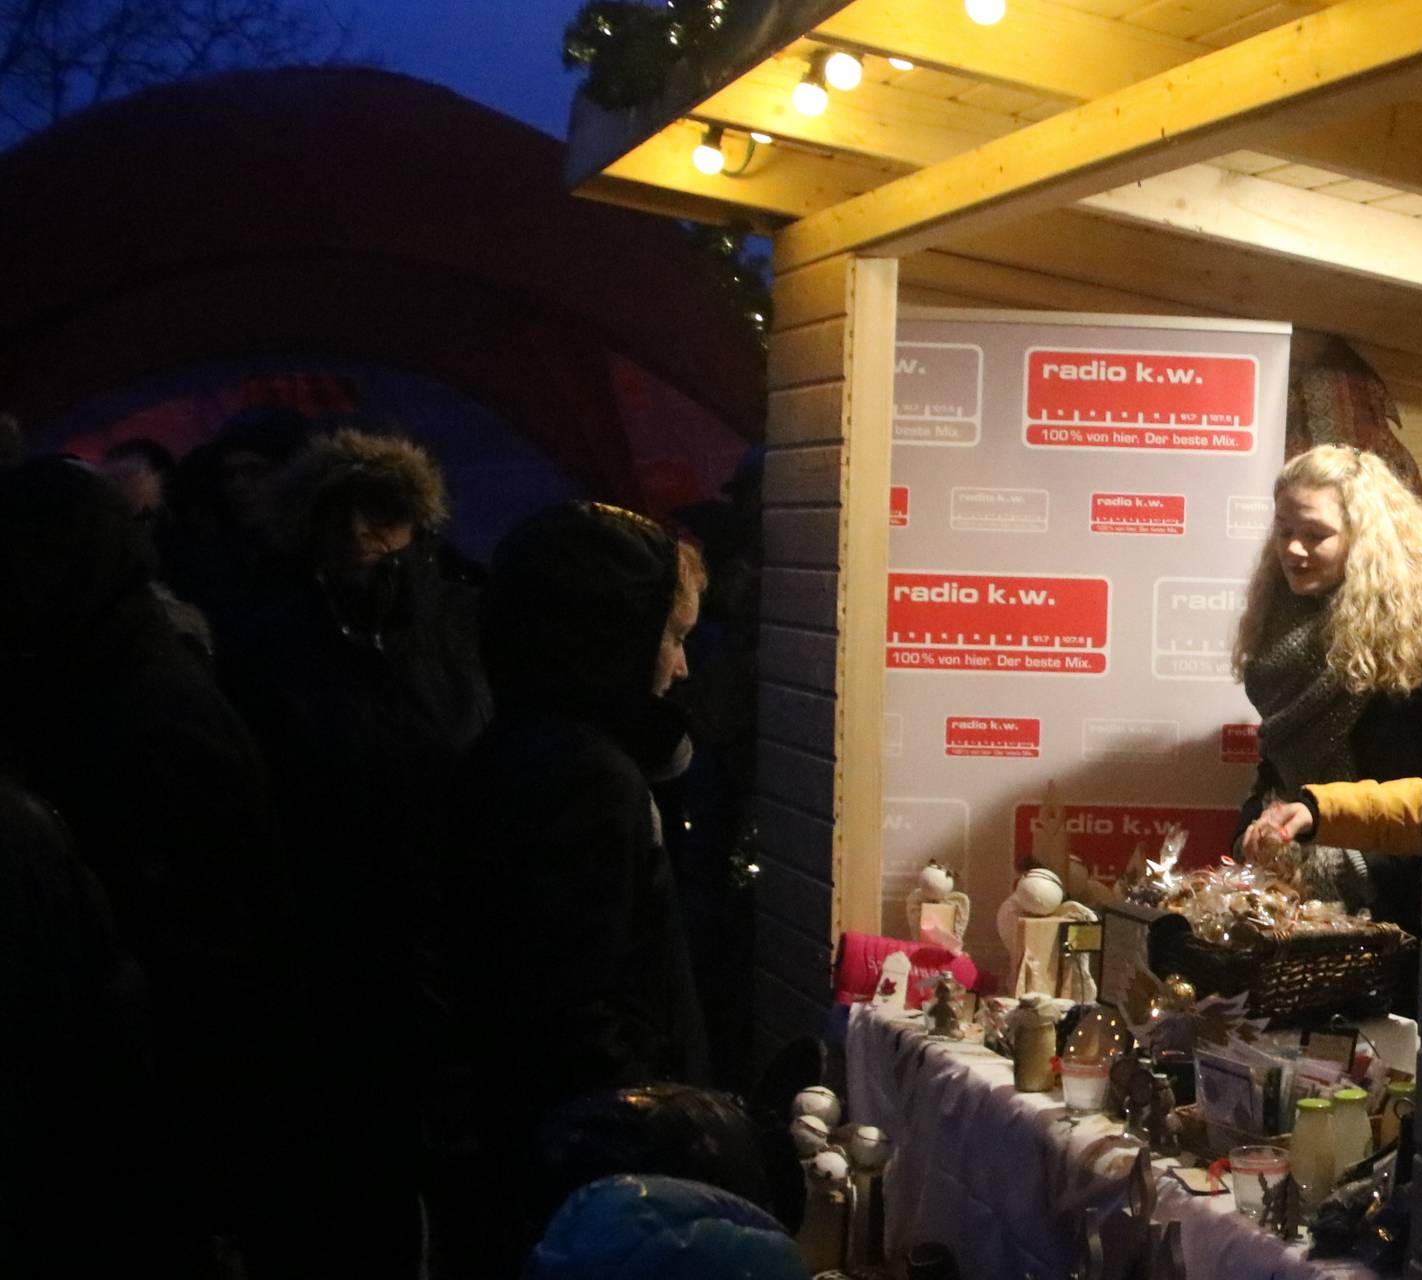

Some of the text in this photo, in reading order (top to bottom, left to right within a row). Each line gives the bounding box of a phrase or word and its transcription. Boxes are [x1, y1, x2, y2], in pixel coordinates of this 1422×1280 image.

[1042, 361, 1203, 384] radio k.w.
[1041, 429, 1239, 448] 100% von hier. Der beste Mix.
[1097, 497, 1164, 508] radio k.w.
[893, 582, 1056, 606] radio k.w.
[892, 652, 1092, 670] 100% von hier. Der beste Mix.
[952, 720, 1019, 731] radio k.w.
[1030, 813, 1114, 835] rdio
